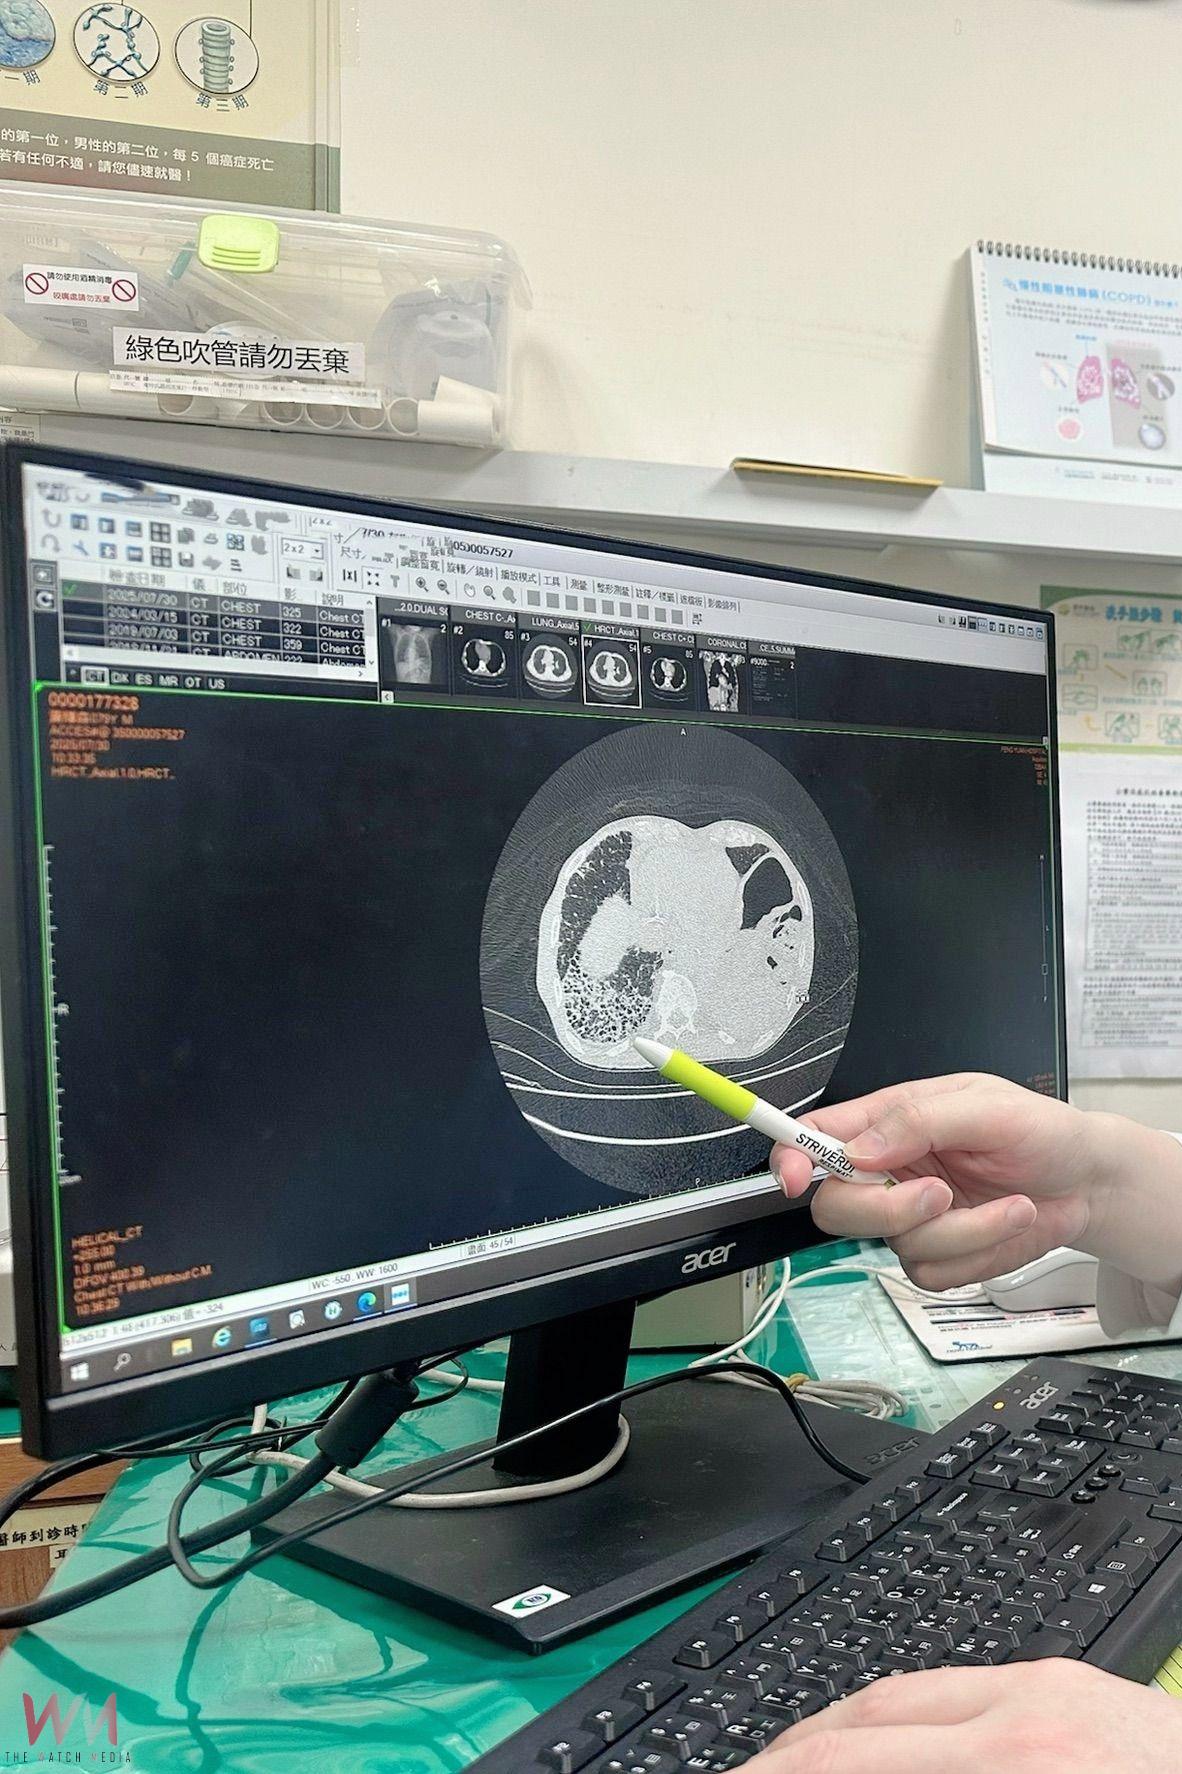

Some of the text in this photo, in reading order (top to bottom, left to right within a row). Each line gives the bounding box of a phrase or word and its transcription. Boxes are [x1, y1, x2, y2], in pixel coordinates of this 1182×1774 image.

[93, 79, 148, 99] 第二期
[195, 92, 249, 113] 第三期
[191, 151, 200, 162] 5
[205, 151, 275, 172] 個癌症死亡
[125, 333, 350, 375] 綠色吹管請勿丟棄
[191, 597, 209, 609] CT
[221, 599, 261, 614] CHEST
[282, 605, 302, 618] 325
[319, 609, 349, 623] Chest
[465, 609, 494, 622] CHEST
[191, 613, 210, 626] CT
[221, 616, 262, 631] CHEST
[282, 621, 302, 635] 322
[319, 625, 349, 639] Chest
[381, 617, 447, 634] #1 2
[453, 625, 464, 636] #2
[192, 630, 210, 643] CT
[222, 633, 262, 647] CHEST
[320, 641, 350, 655] Chest
[520, 632, 578, 647] #3 54
[652, 630, 678, 643] CHEST
[87, 669, 226, 690] CT DX ES MR OT US
[795, 1132, 856, 1173] STRIVERDI
[681, 1240, 737, 1274] acer
[379, 1262, 399, 1276] 1600
[1019, 1381, 1060, 1411] acer
[0, 1521, 87, 1546] 醫師到診時
